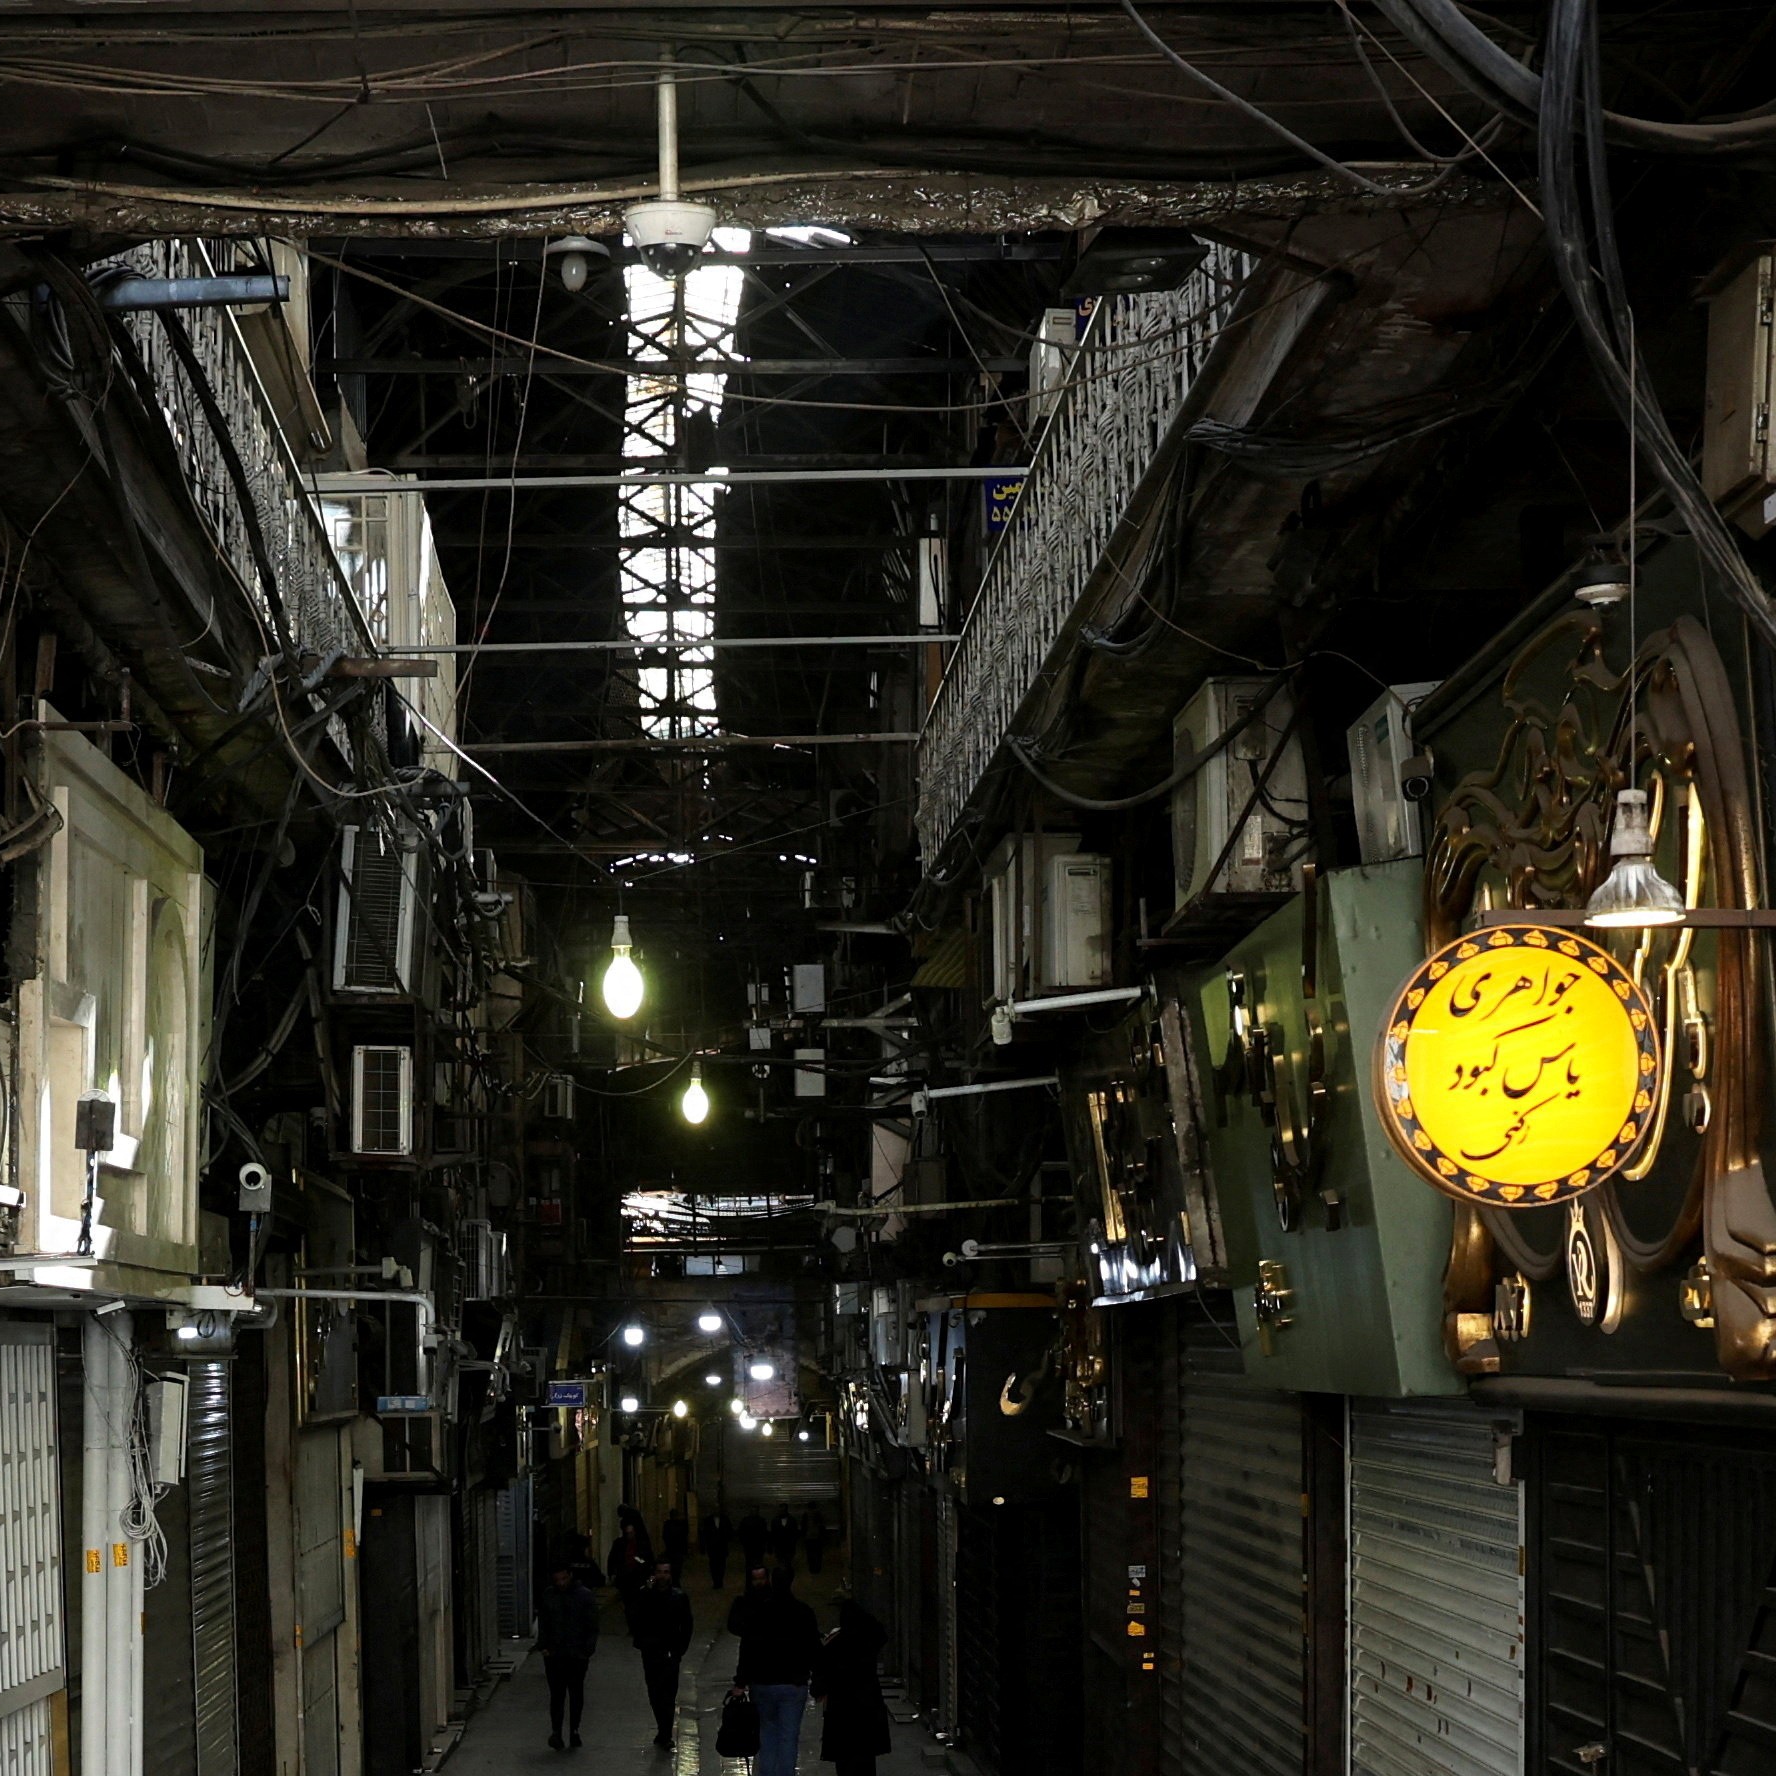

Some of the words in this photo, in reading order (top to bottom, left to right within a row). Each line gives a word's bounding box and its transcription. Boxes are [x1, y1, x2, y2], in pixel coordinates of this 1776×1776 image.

[1449, 965, 1582, 1021] جواهری
[1448, 1013, 1558, 1096] کبود
[1502, 1041, 1582, 1100] یاس
